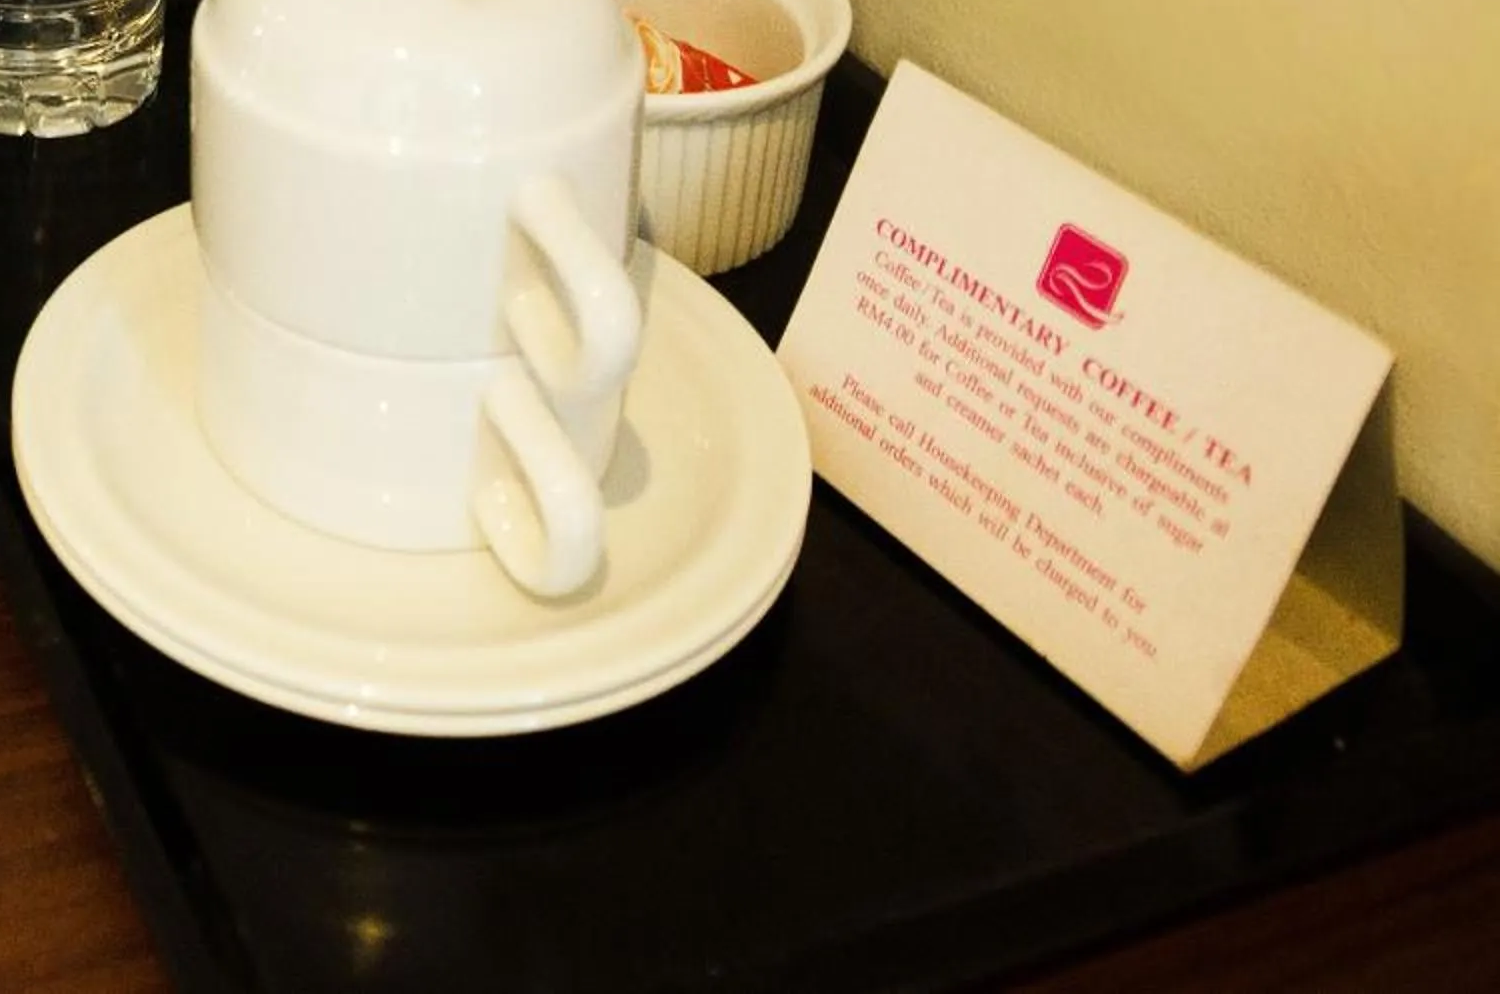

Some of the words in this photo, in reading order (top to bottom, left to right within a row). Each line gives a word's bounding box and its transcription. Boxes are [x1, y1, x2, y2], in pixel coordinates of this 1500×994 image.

[856, 271, 890, 300] once
[934, 321, 1015, 388] Additional
[1016, 380, 1081, 435] requests
[1084, 430, 1111, 455] are
[1115, 451, 1206, 524] chargeable
[1209, 518, 1231, 540] at
[856, 295, 916, 347] RM4.00
[918, 338, 942, 366] for
[944, 358, 995, 404] Coffee
[998, 400, 1017, 420] or
[1021, 411, 1050, 445] Tea
[1054, 438, 1129, 500] inclusive
[1131, 496, 1156, 517] of
[1156, 513, 1204, 555] sugar
[874, 250, 922, 292] Coffee
[958, 306, 975, 329] is
[974, 323, 1047, 377] provided
[1050, 372, 1084, 404] with
[1088, 400, 1119, 427] our
[1120, 424, 1230, 505] compliments
[875, 218, 1070, 357] COMPLIMENTARY
[1081, 357, 1180, 435] COFFEE
[1204, 435, 1252, 487] TEA
[914, 371, 945, 398] and
[945, 394, 1007, 444] creamer
[1009, 440, 1061, 485] sachet
[808, 384, 878, 442] additional
[879, 438, 925, 478] orders
[928, 473, 974, 516] which
[978, 511, 1009, 542] will
[1011, 533, 1032, 560] be
[1034, 547, 1099, 613] charged
[1101, 607, 1119, 629] to
[841, 373, 887, 418] Please
[888, 413, 916, 440] call
[917, 431, 1022, 528] Housekeeping
[1024, 512, 1118, 592] Department
[1120, 586, 1148, 615] for
